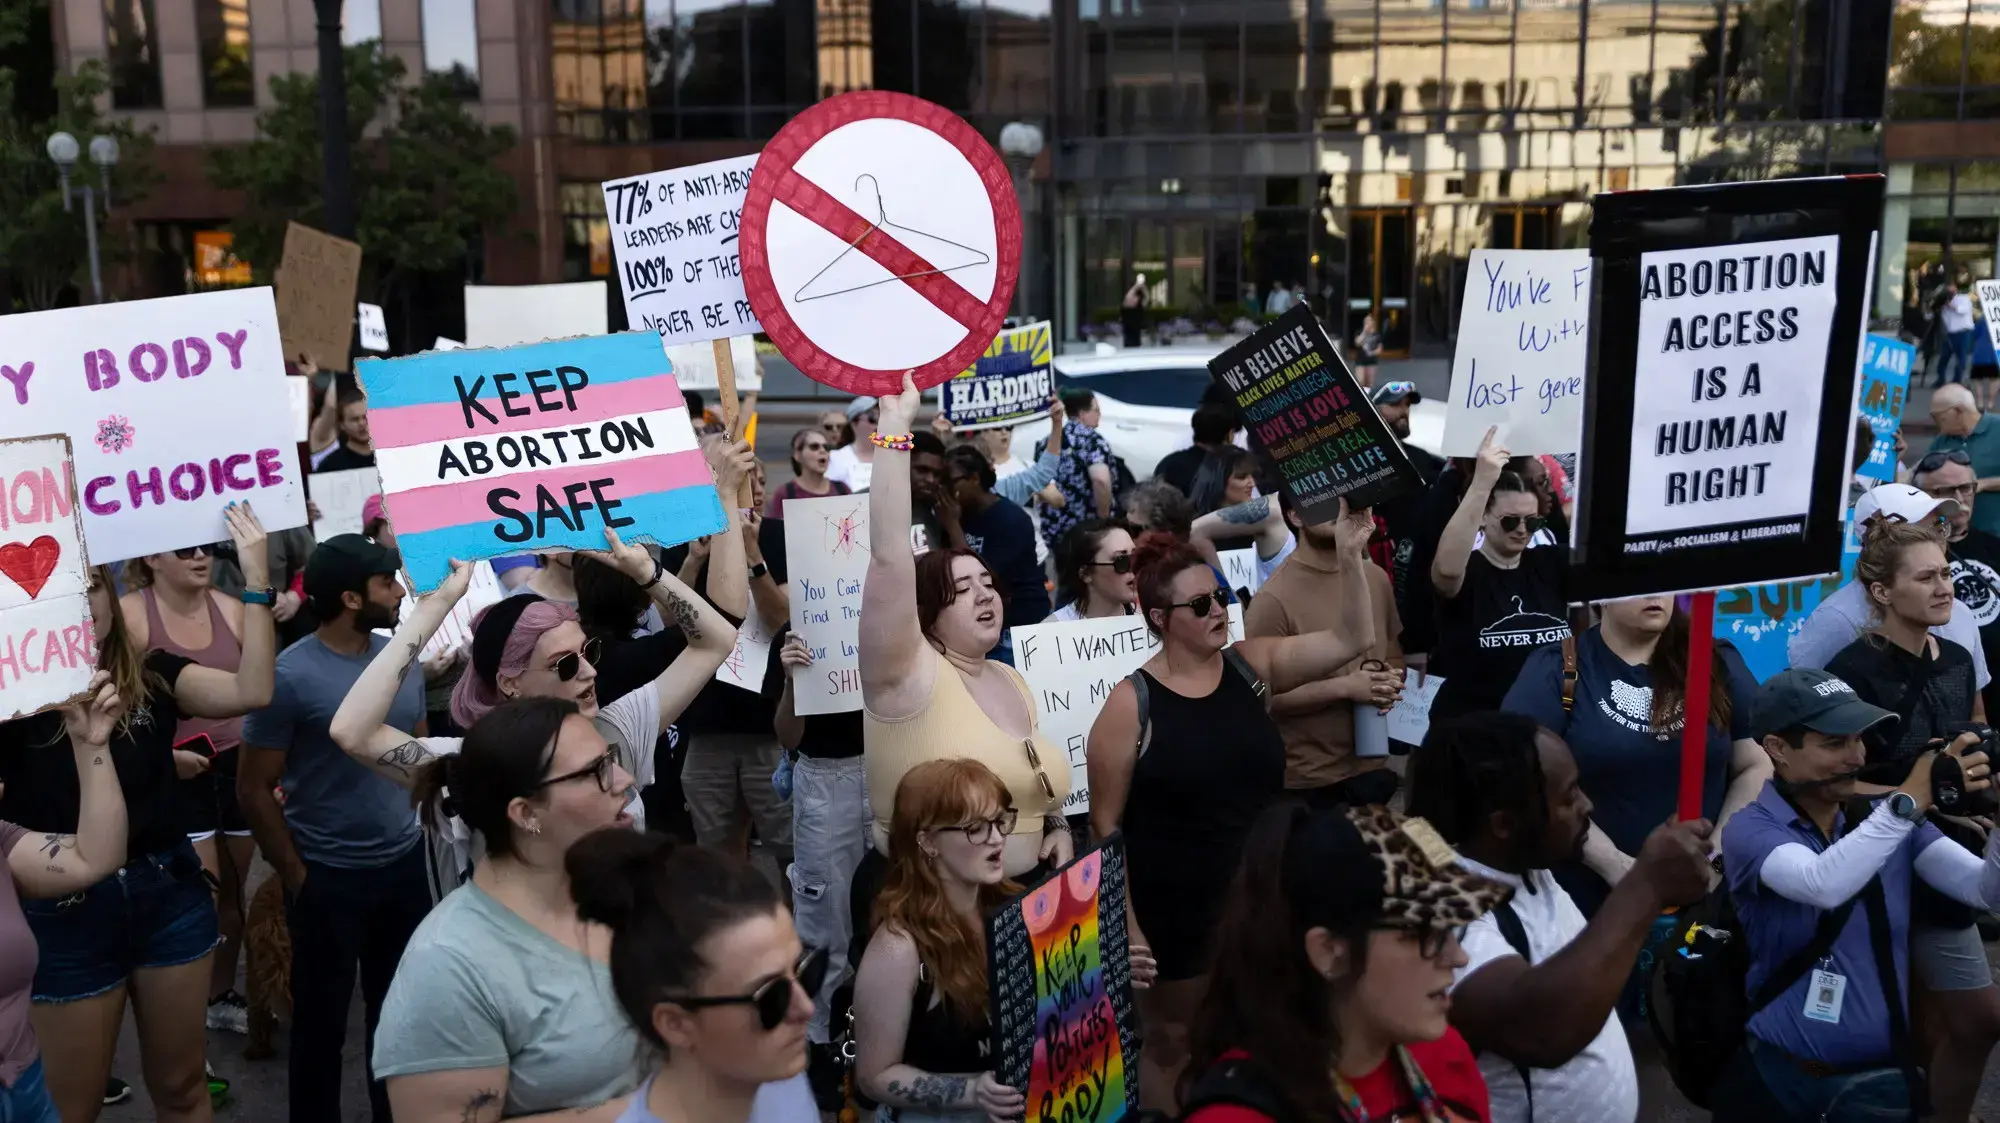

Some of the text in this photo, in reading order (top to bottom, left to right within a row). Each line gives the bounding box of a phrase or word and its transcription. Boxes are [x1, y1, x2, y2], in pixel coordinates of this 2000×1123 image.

[606, 180, 652, 225] 77%
[658, 183, 675, 204] OF
[624, 221, 684, 248] LEADERS
[687, 214, 715, 237] ARE
[625, 256, 673, 291] 100%
[683, 260, 703, 283] OF
[1484, 258, 1551, 312] You've
[1641, 250, 1826, 301] ABORTION
[642, 300, 757, 336] NEVER BE PR
[1662, 306, 1799, 352] ACCESS
[0, 329, 248, 405] Y BODY
[1222, 325, 1314, 392] WE BELIEVE
[453, 366, 589, 428] KEEP
[950, 369, 1050, 411] HARDING
[1236, 352, 1324, 408] BLACK LIVES MATTER
[1245, 367, 1336, 423] NO HUMAN IS ILLEGAL
[1467, 358, 1581, 414] last gene
[1692, 362, 1762, 402] IS A
[951, 407, 993, 420] STATE
[997, 404, 1019, 415] REP
[1022, 398, 1043, 410] DIST
[1256, 386, 1350, 445] LOVE IS LOVE
[1336, 410, 1360, 430] Rights
[438, 417, 654, 479] ABORTION
[1655, 410, 1788, 456] HUMAN
[1279, 428, 1375, 480] SCIENCE IS REAL
[1290, 470, 1330, 496] WATER
[1330, 463, 1348, 480] IS
[1350, 446, 1387, 472] LIFE
[1365, 466, 1395, 482] Everywhere
[84, 448, 284, 516] CHOICE
[1664, 462, 1770, 506] RIGHT
[487, 478, 635, 543] SAFE
[1624, 523, 1800, 552] PARTY for SOCIALISM & LIBERATION
[1230, 554, 1252, 584] My
[800, 578, 861, 602] You Can't
[803, 610, 829, 624] Find
[1020, 626, 1157, 671] IF I WANTED
[1479, 628, 1572, 648] NEVER AGAIN
[1044, 690, 1070, 713] IN
[1598, 698, 1615, 716] FIGHT
[1612, 714, 1627, 725] FOR
[1626, 720, 1640, 732] THE
[1102, 844, 1114, 864] MY
[1102, 853, 1122, 880] BODY
[1100, 882, 1109, 896] MY
[996, 948, 1005, 964] MY
[997, 967, 1006, 983] MY
[1042, 923, 1080, 996] KEEP
[999, 960, 1028, 998] MY BODY
[1053, 952, 1093, 1016] YOUR
[1000, 998, 1010, 1012] MY
[1001, 993, 1036, 1034] MY BODY
[1112, 992, 1123, 1008] MY
[1003, 1037, 1012, 1052] MY
[1045, 1001, 1108, 1083] POLICIES
[1040, 1041, 1110, 1123] BODY
[1059, 1069, 1074, 1098] OFF
